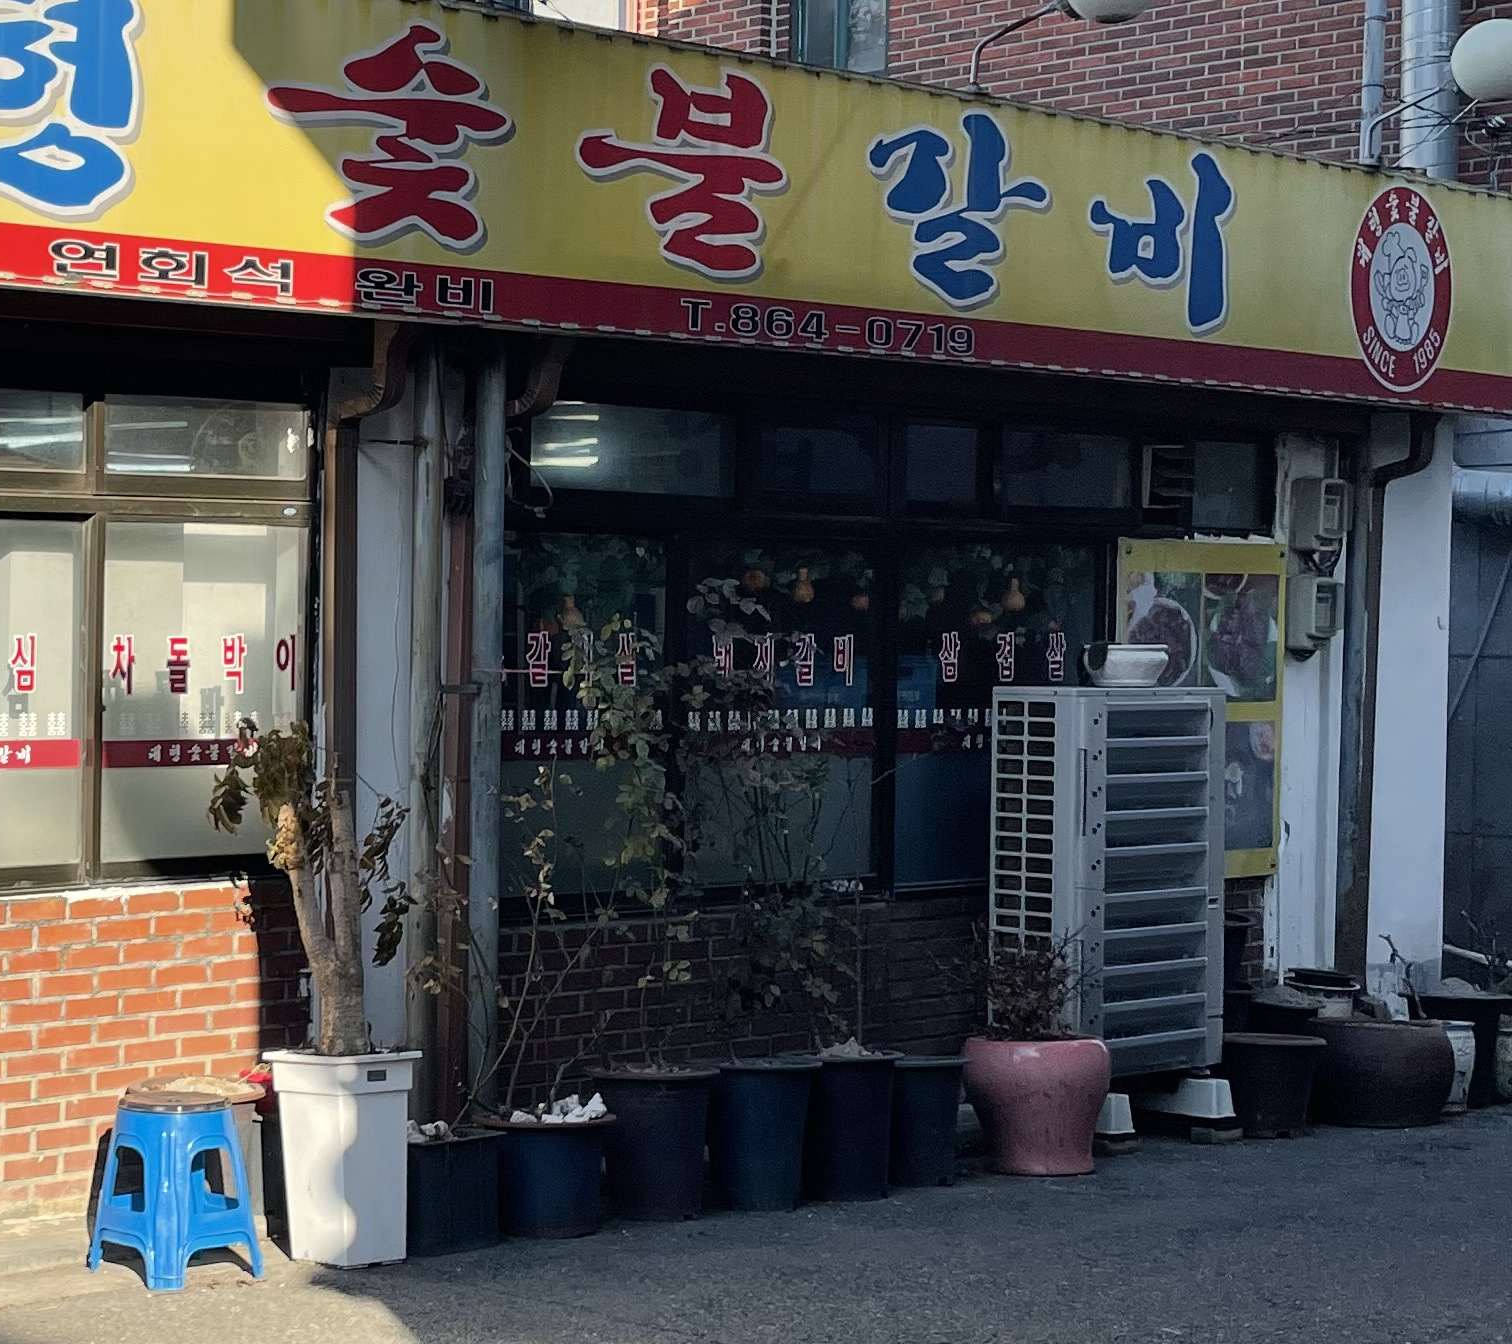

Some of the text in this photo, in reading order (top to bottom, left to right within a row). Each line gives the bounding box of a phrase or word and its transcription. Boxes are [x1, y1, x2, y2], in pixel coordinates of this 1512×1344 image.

[48, 237, 496, 316] 연회석 완비
[1362, 324, 1441, 378] SINCE 1985
[110, 632, 297, 696] 차돌박이
[938, 630, 1067, 683] 삼겹살
